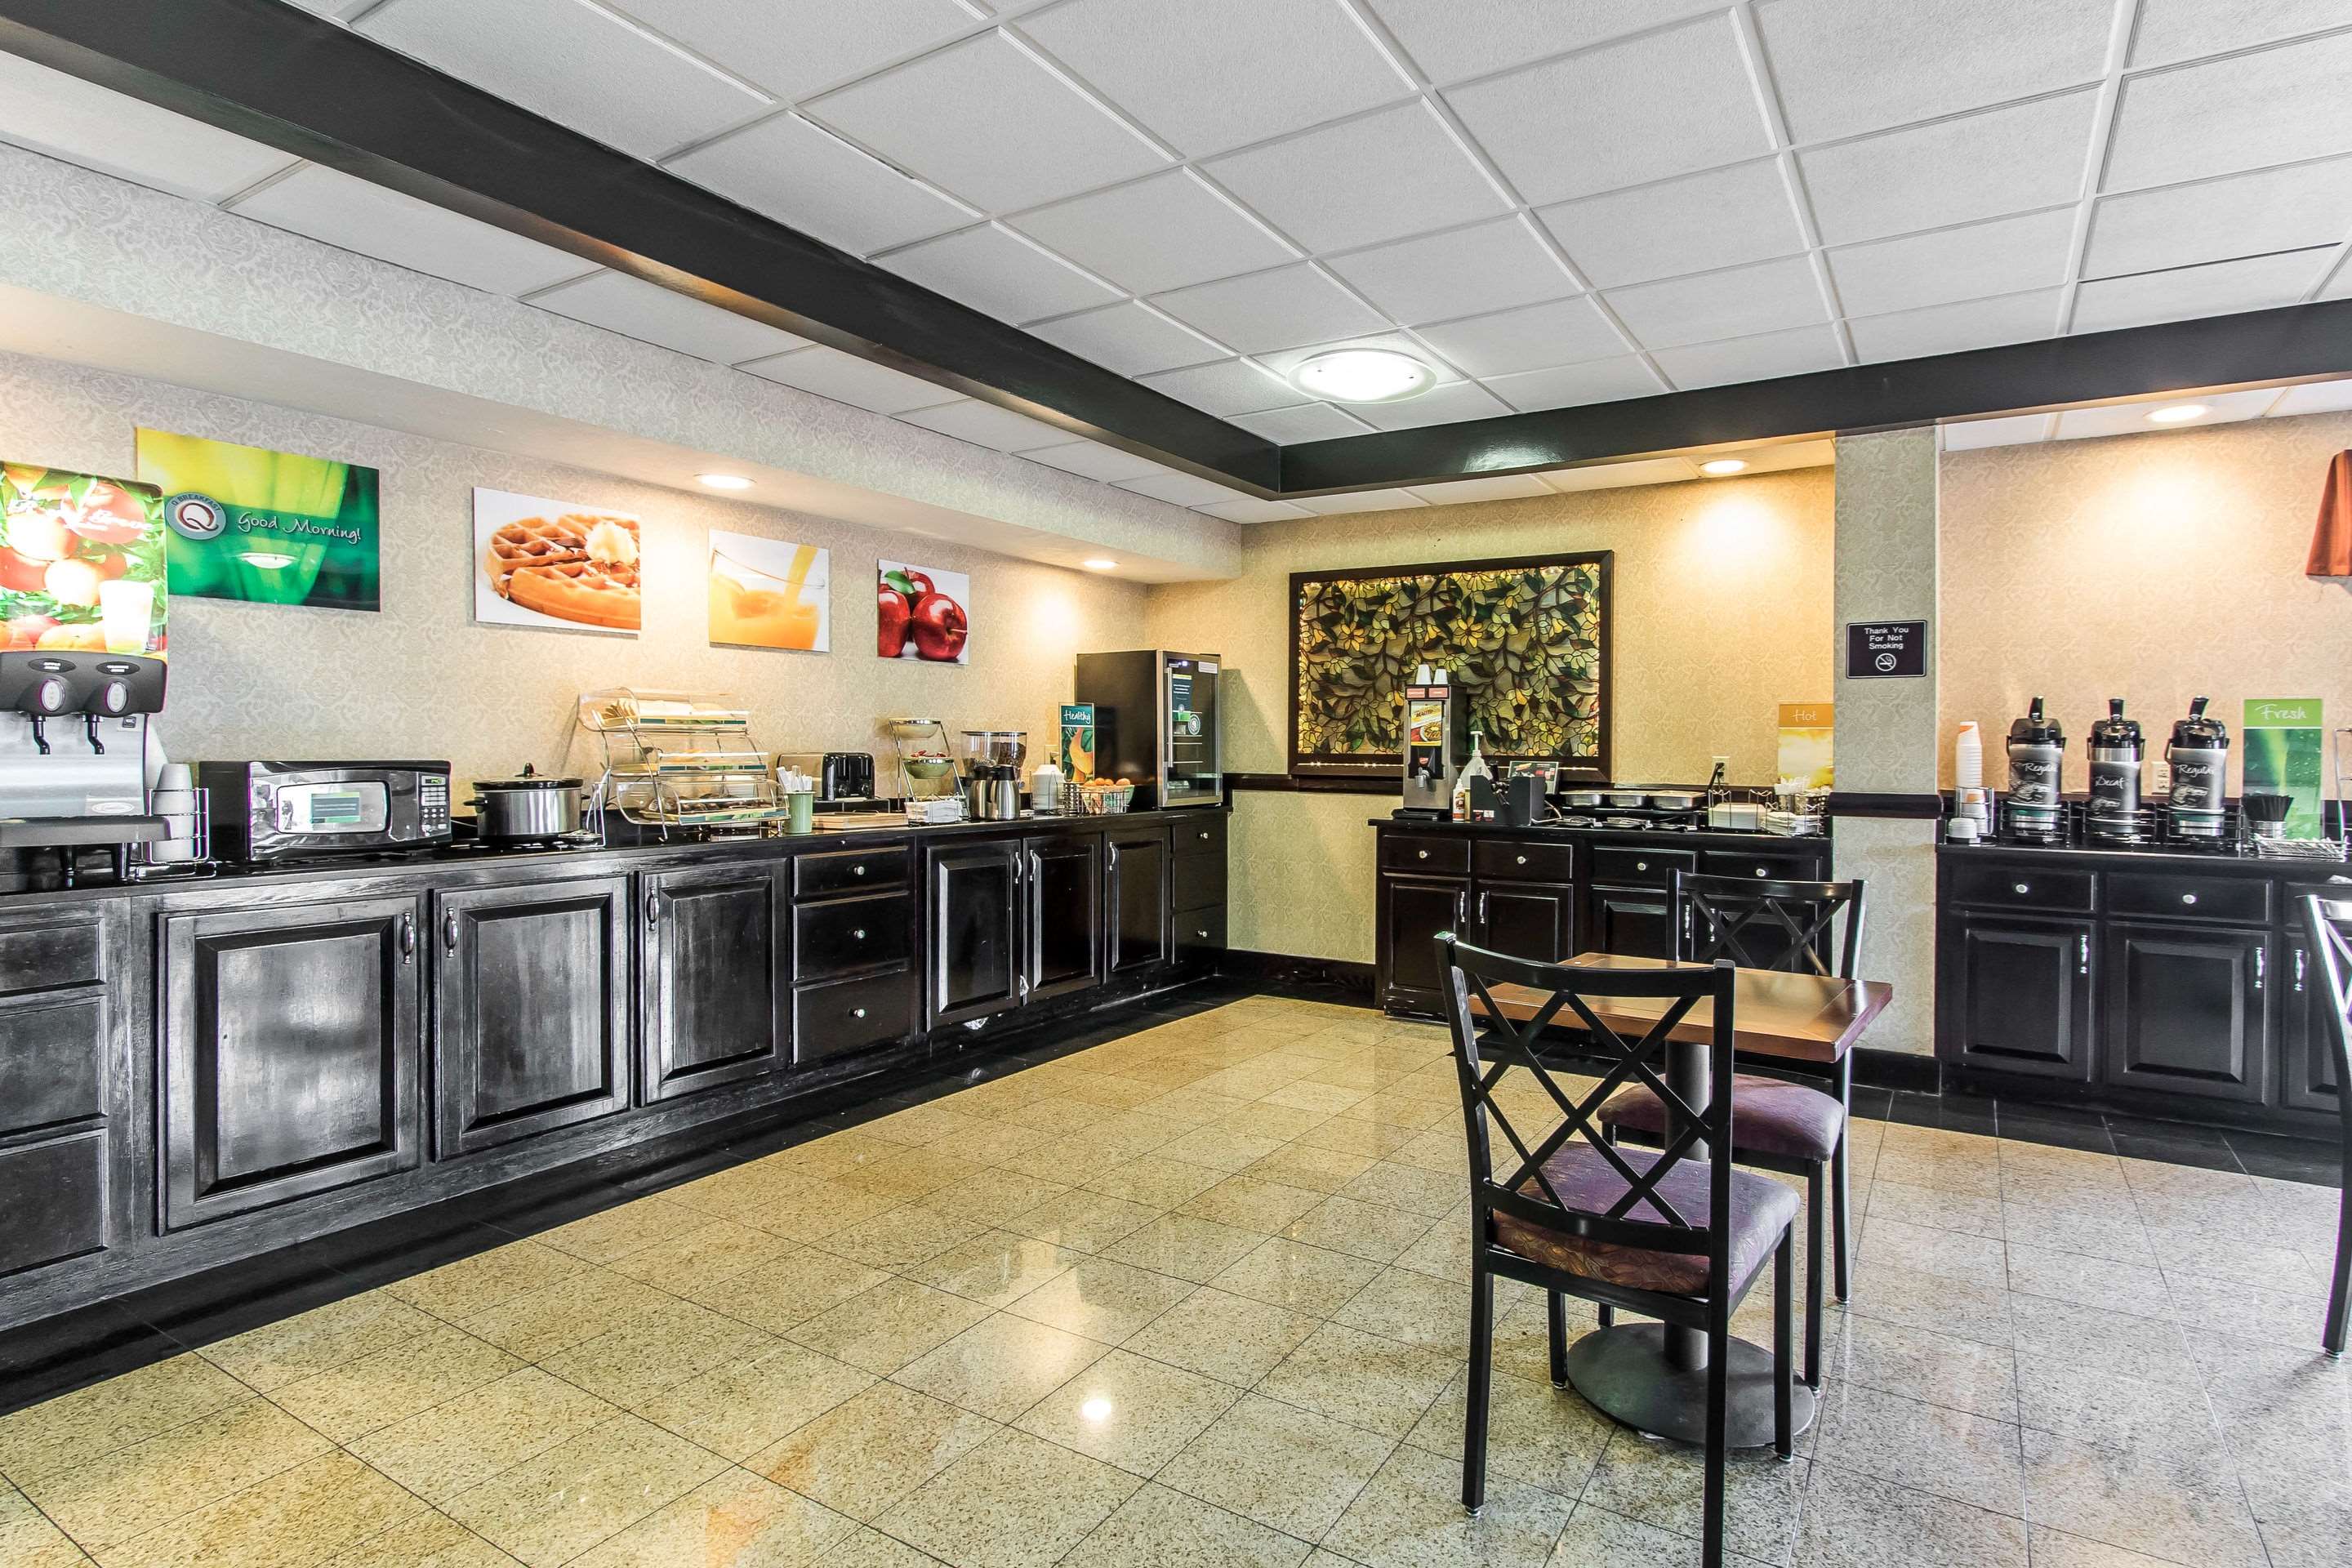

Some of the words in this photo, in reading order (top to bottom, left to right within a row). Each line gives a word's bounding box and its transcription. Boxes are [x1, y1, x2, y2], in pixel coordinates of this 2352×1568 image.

[238, 511, 278, 532] Good
[283, 519, 361, 545] Morning!
[1869, 642, 1904, 650] Smoking
[1063, 709, 1091, 724] Healthy
[1790, 709, 1816, 723] Hot
[2255, 703, 2307, 719] Fresh
[2095, 775, 2126, 790] Decaf
